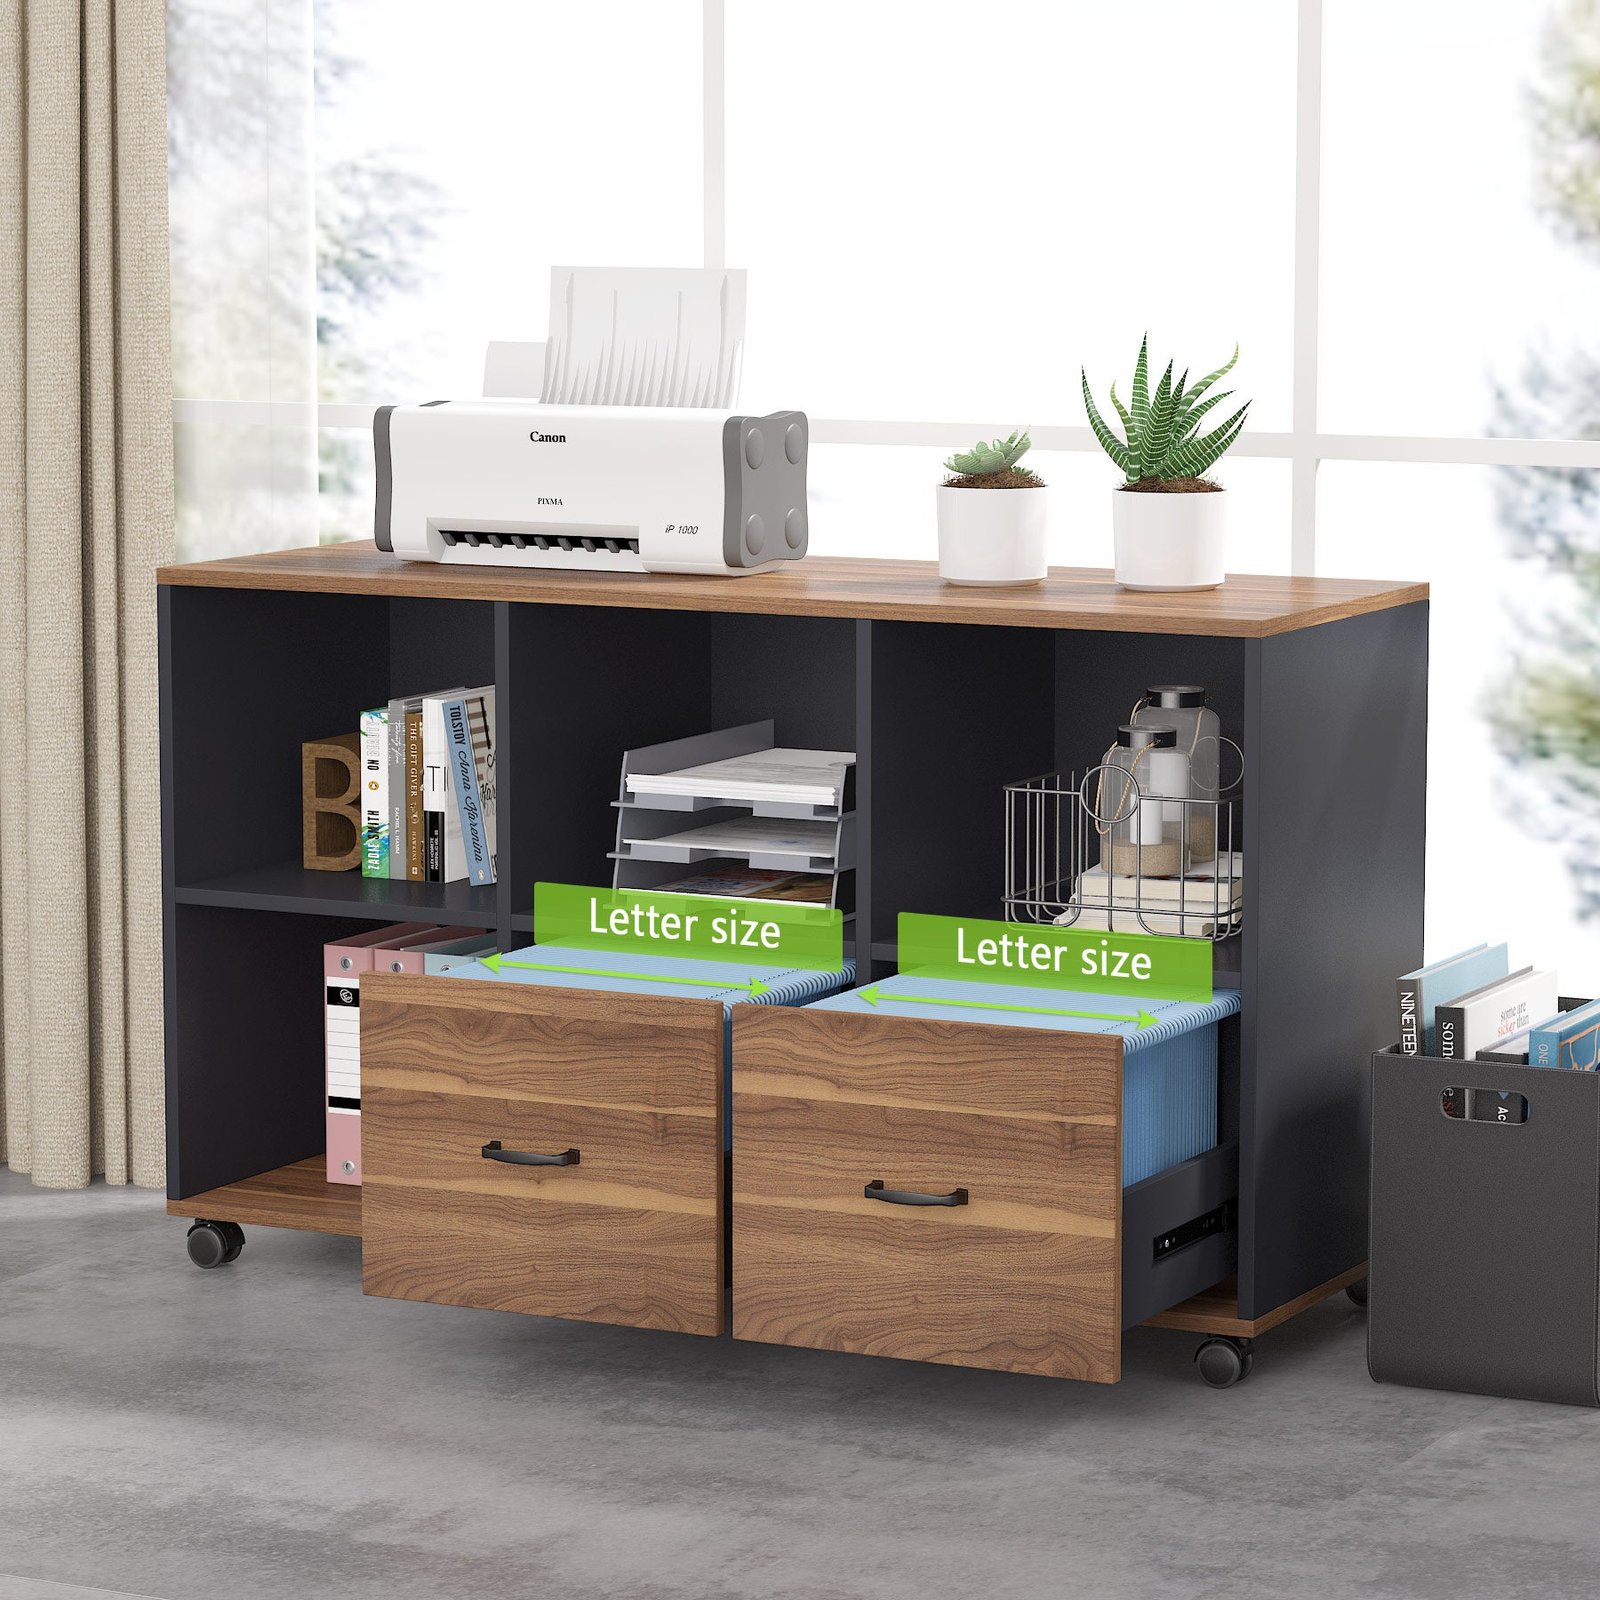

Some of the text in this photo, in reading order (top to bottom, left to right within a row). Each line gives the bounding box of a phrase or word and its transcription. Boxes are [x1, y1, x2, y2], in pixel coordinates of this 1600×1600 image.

[530, 431, 567, 443] Canon
[537, 497, 564, 506] PIXMA
[664, 524, 699, 535] iP 1000
[367, 759, 380, 771] ON
[410, 743, 418, 765] GIFT
[410, 768, 418, 796] GIVER
[449, 705, 483, 863] TOLSTOY Anna Karenina
[302, 742, 362, 872] B
[367, 810, 380, 870] ZADIE SMITH
[1538, 1043, 1549, 1065] ONE
